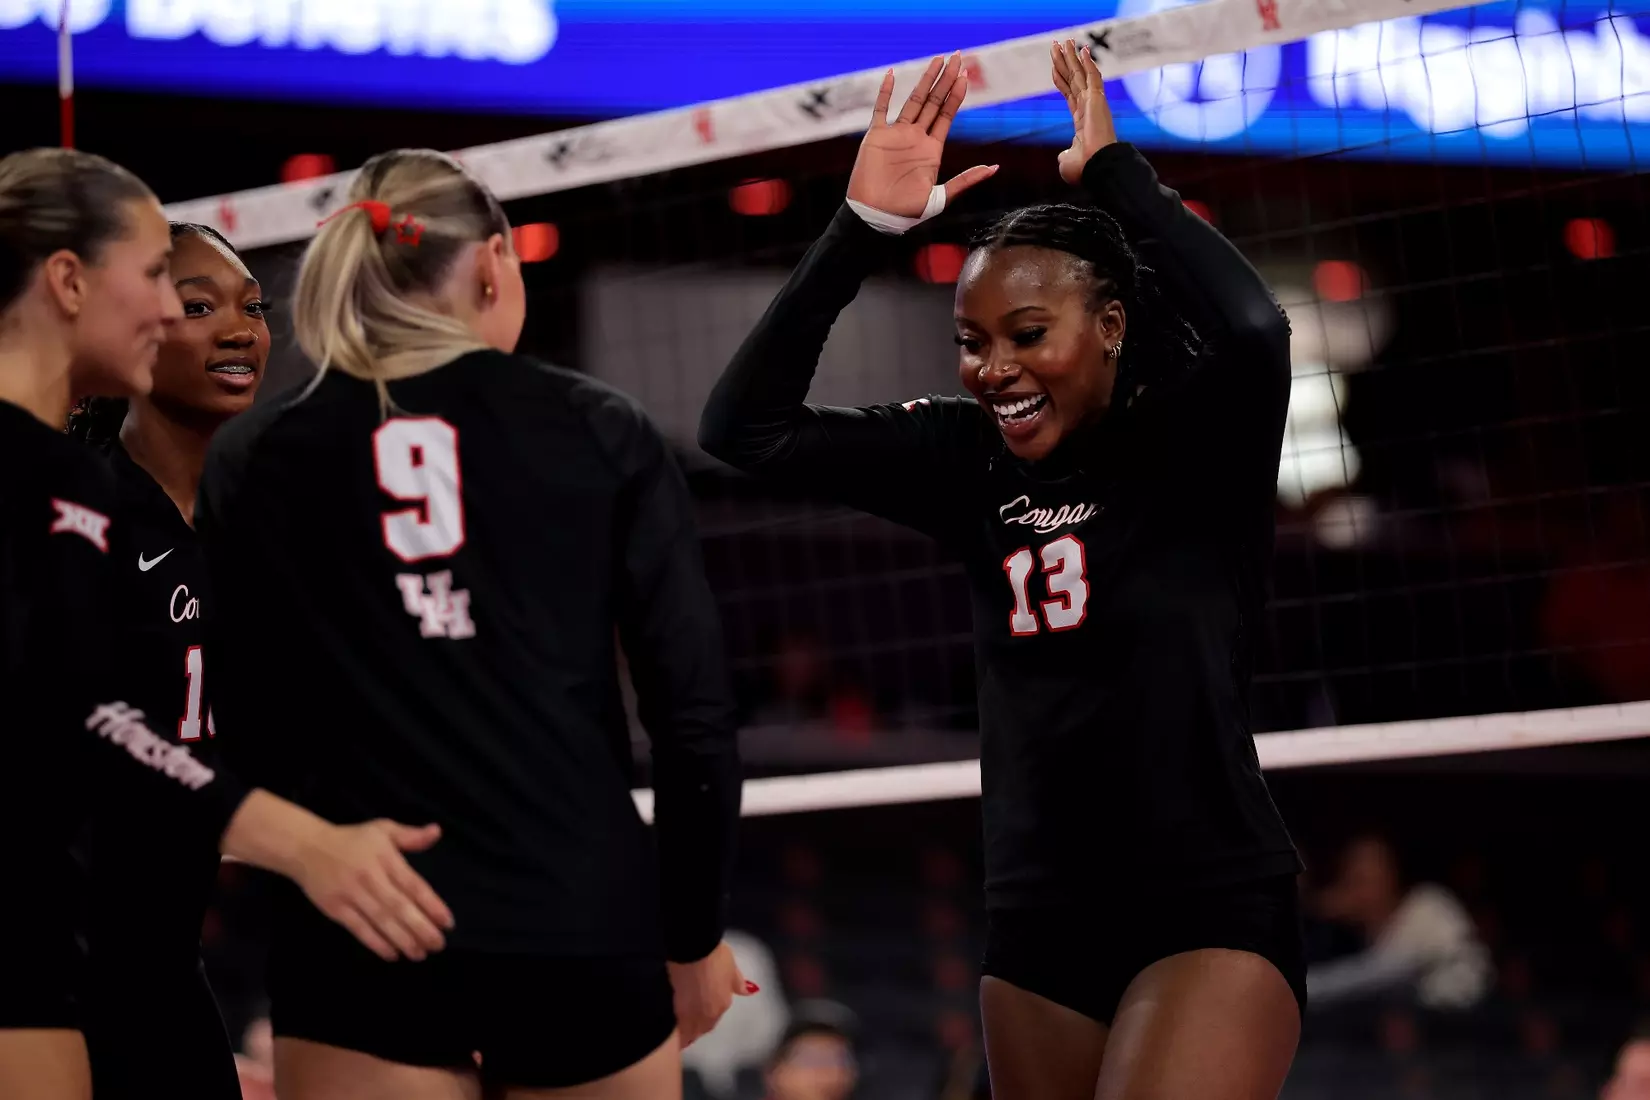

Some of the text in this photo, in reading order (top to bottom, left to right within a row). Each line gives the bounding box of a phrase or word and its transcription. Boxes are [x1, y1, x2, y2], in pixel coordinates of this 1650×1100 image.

[372, 415, 465, 563] 9
[999, 495, 1104, 534] Cougar
[1003, 533, 1090, 636] 13
[178, 644, 216, 743] 1
